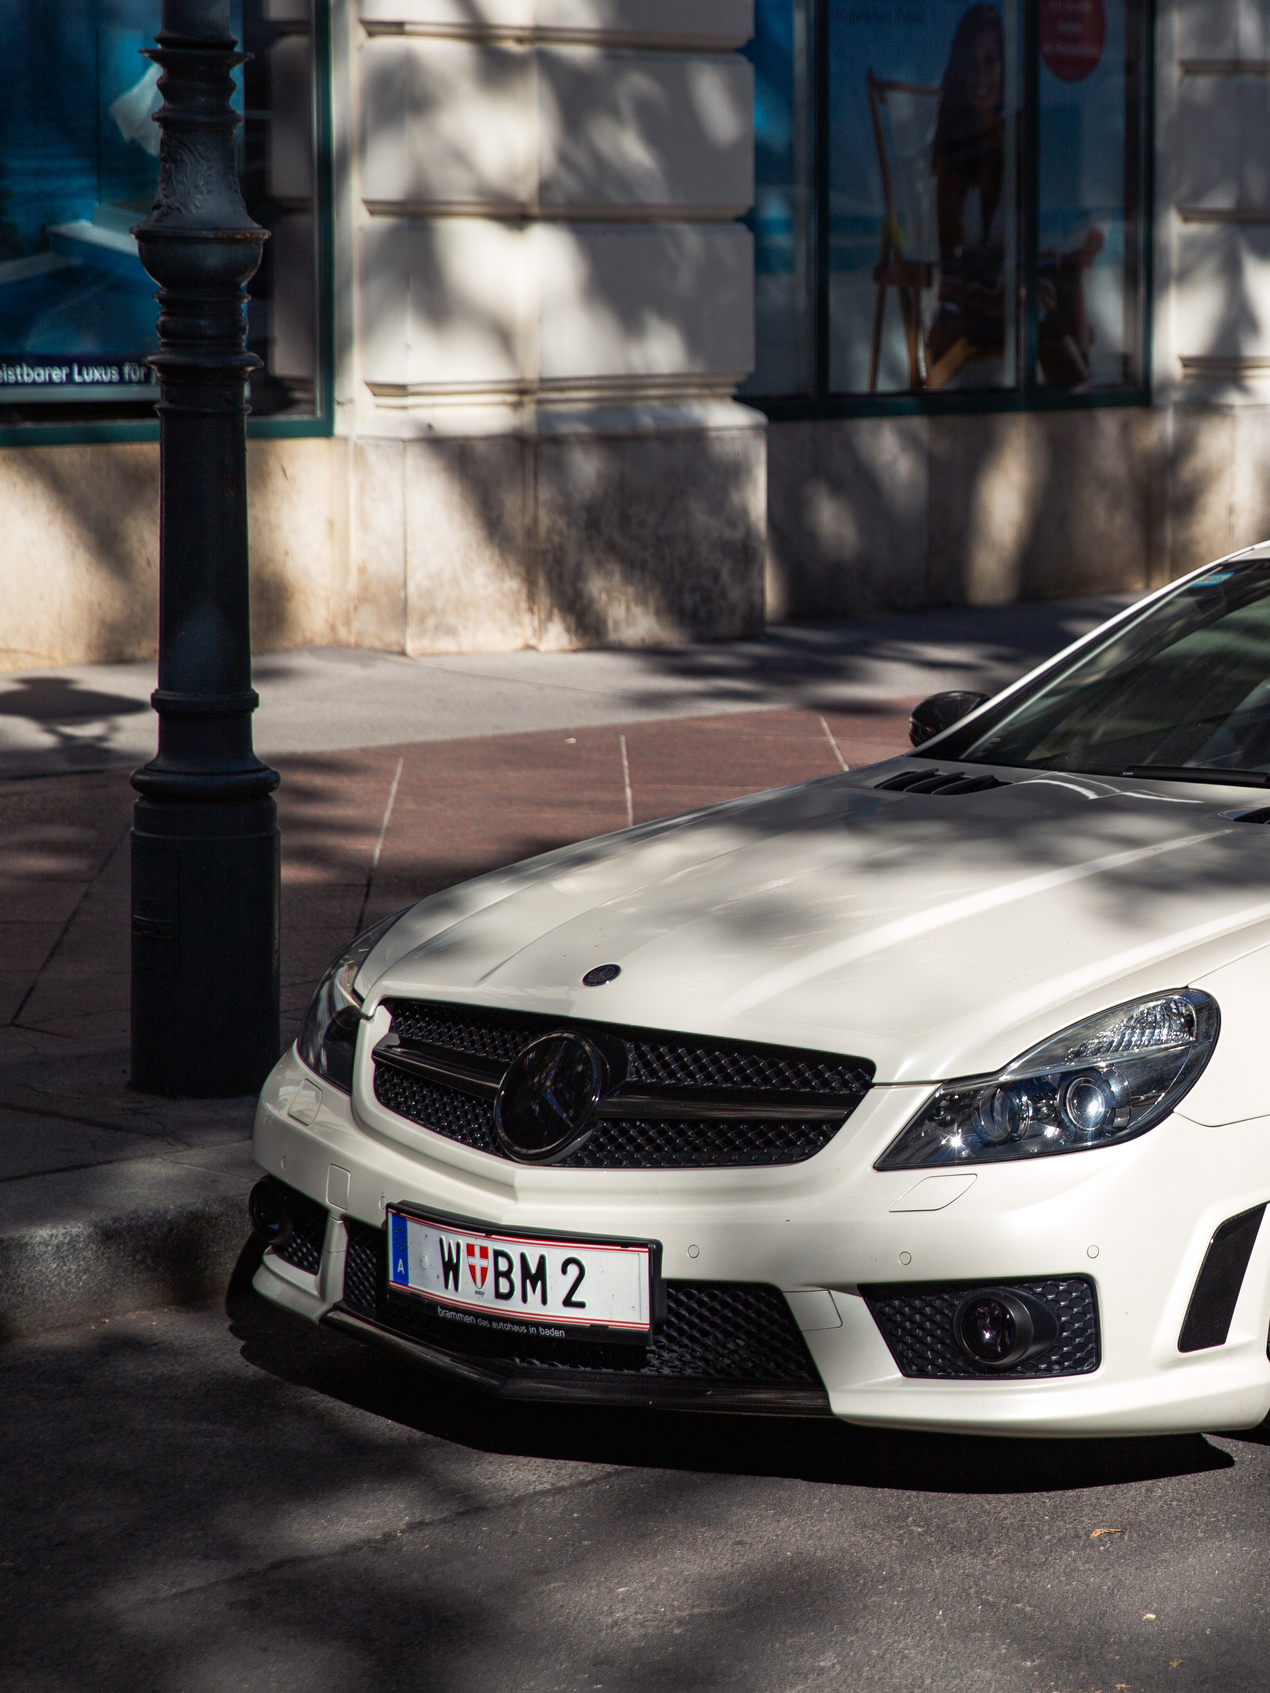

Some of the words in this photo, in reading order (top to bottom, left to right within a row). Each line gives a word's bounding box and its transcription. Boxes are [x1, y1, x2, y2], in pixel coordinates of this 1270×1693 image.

[0, 362, 69, 384] istbarer
[72, 362, 119, 384] Luxus
[123, 363, 147, 383] für
[397, 1258, 405, 1275] A
[439, 1235, 462, 1292] W
[493, 1248, 549, 1306] BM
[561, 1256, 587, 1308] 2
[437, 1305, 476, 1324] brammen
[477, 1317, 490, 1328] das
[491, 1321, 527, 1333] autohaus
[528, 1325, 537, 1334] in
[539, 1326, 566, 1338] baden
